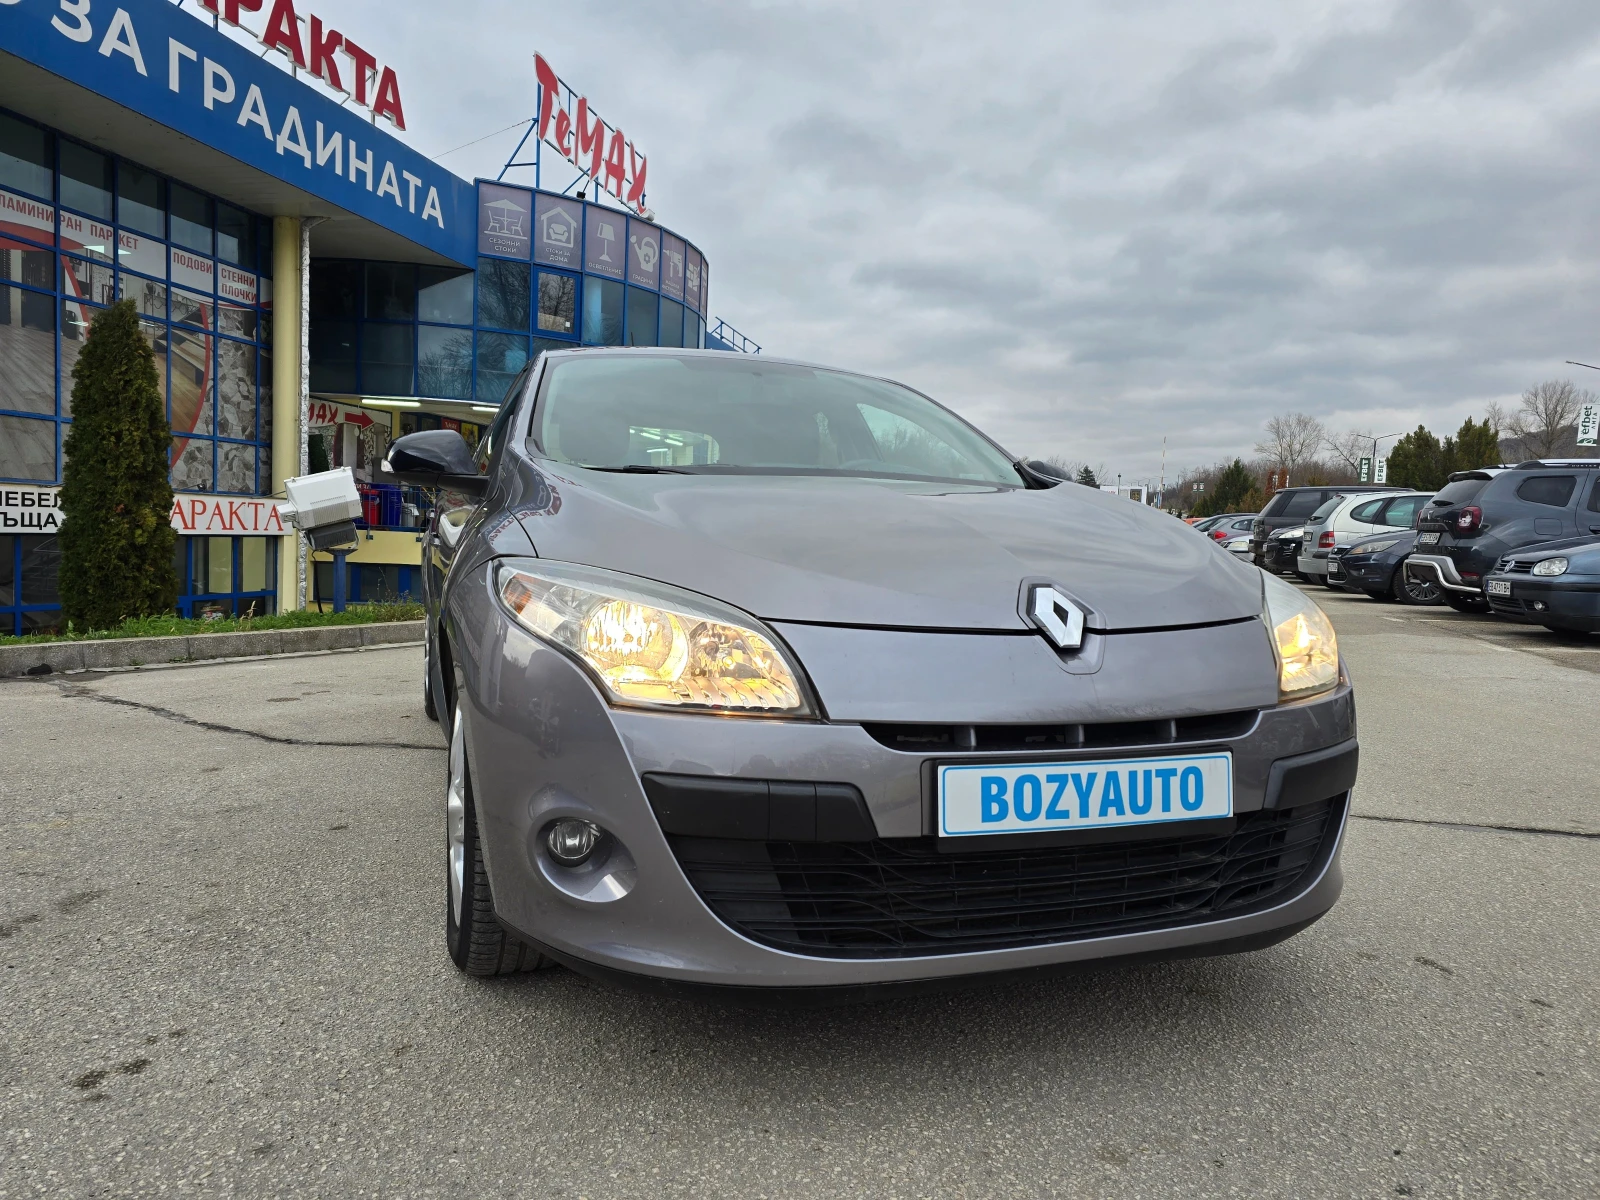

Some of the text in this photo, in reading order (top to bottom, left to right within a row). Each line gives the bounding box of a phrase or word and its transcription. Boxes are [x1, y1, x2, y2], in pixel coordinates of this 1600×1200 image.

[197, 0, 406, 131] АКТА
[50, 0, 445, 230] ЗА ГРАДИНАТА
[90, 224, 139, 250] ПАРКЕТ
[494, 245, 517, 253] СТОКИ
[173, 252, 255, 288] ПОДОВИ СТЕННИ
[549, 254, 568, 263] ДОМА
[221, 283, 257, 303] ПЛОЧКИ
[1581, 405, 1593, 435] efbet
[1360, 459, 1369, 482] EFBET
[1377, 459, 1385, 482] EFBET
[980, 766, 1204, 824] BOZYAUTO
